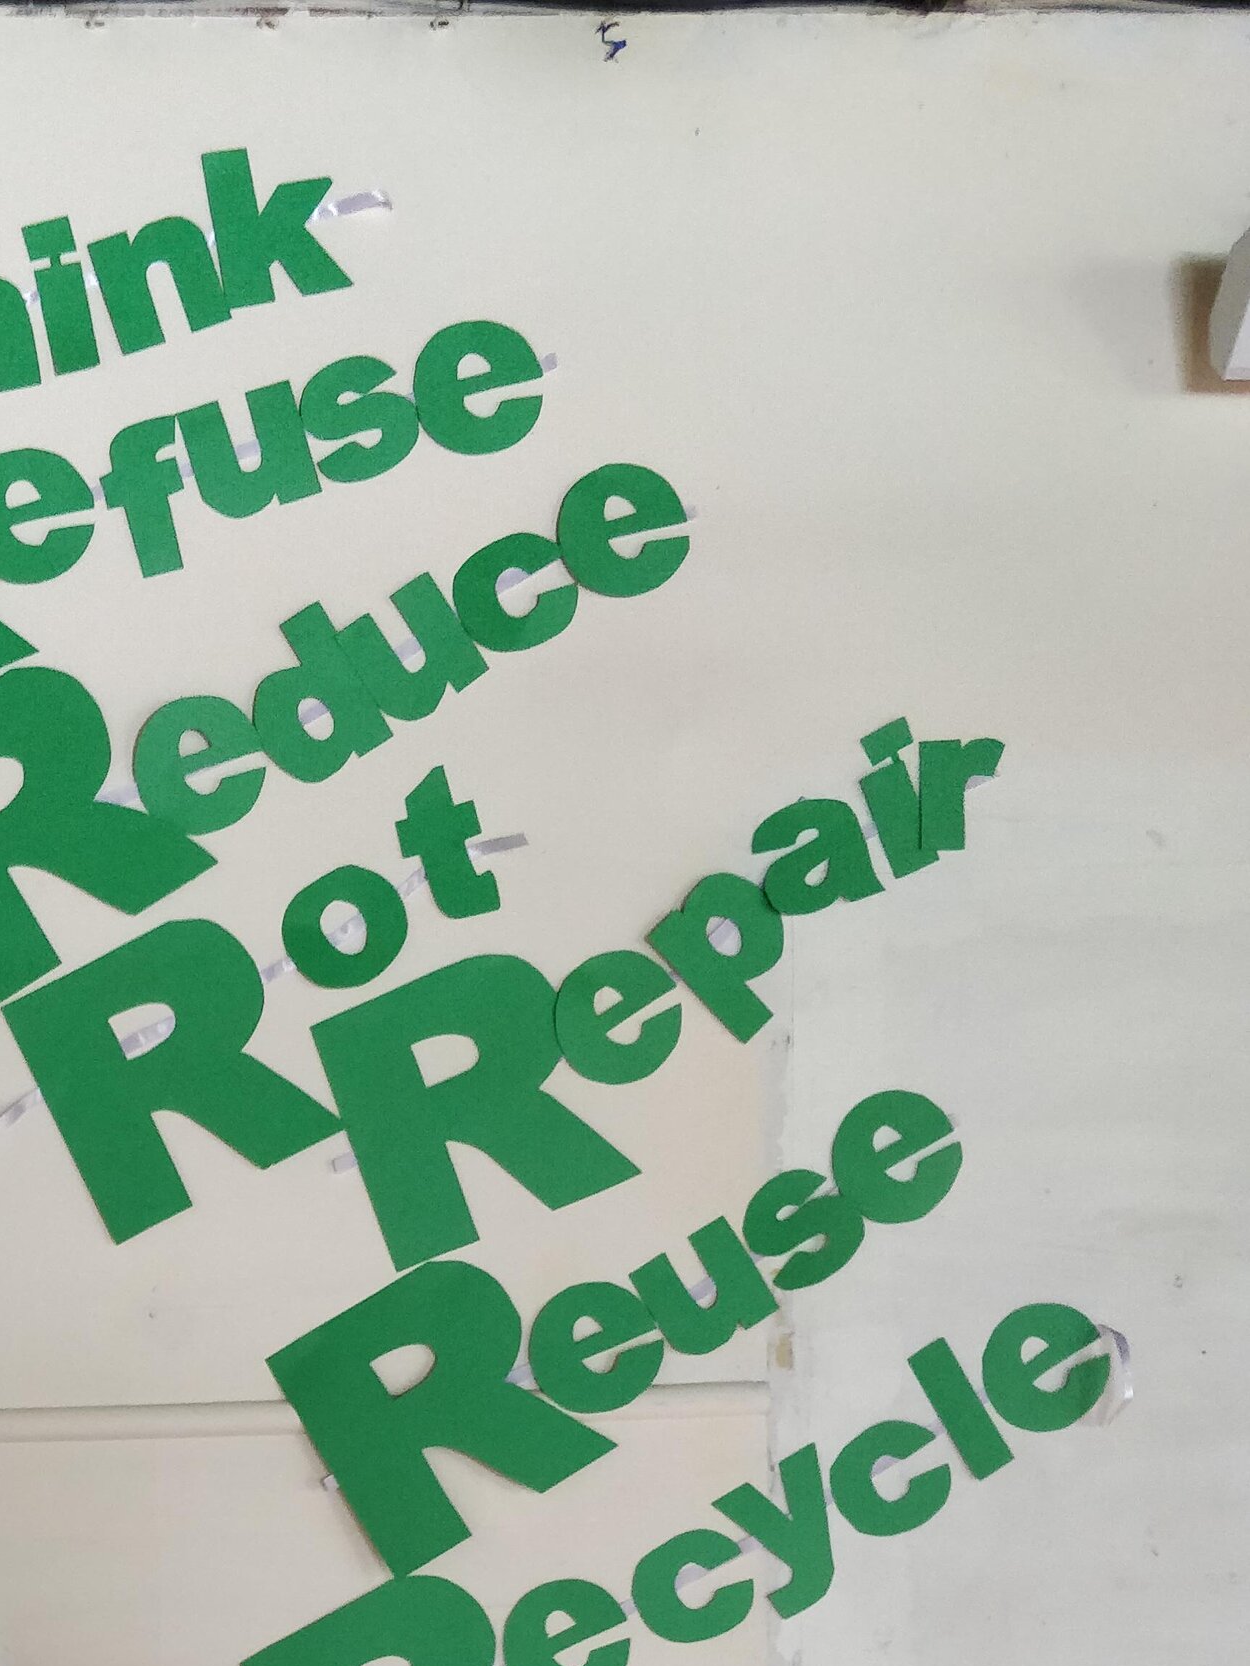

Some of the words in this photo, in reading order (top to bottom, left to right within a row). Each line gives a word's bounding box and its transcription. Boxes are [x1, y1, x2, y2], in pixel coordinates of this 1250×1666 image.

[1, 765, 500, 1245] Rot
[311, 717, 1004, 1272] Repair
[265, 1090, 962, 1580] Reuse
